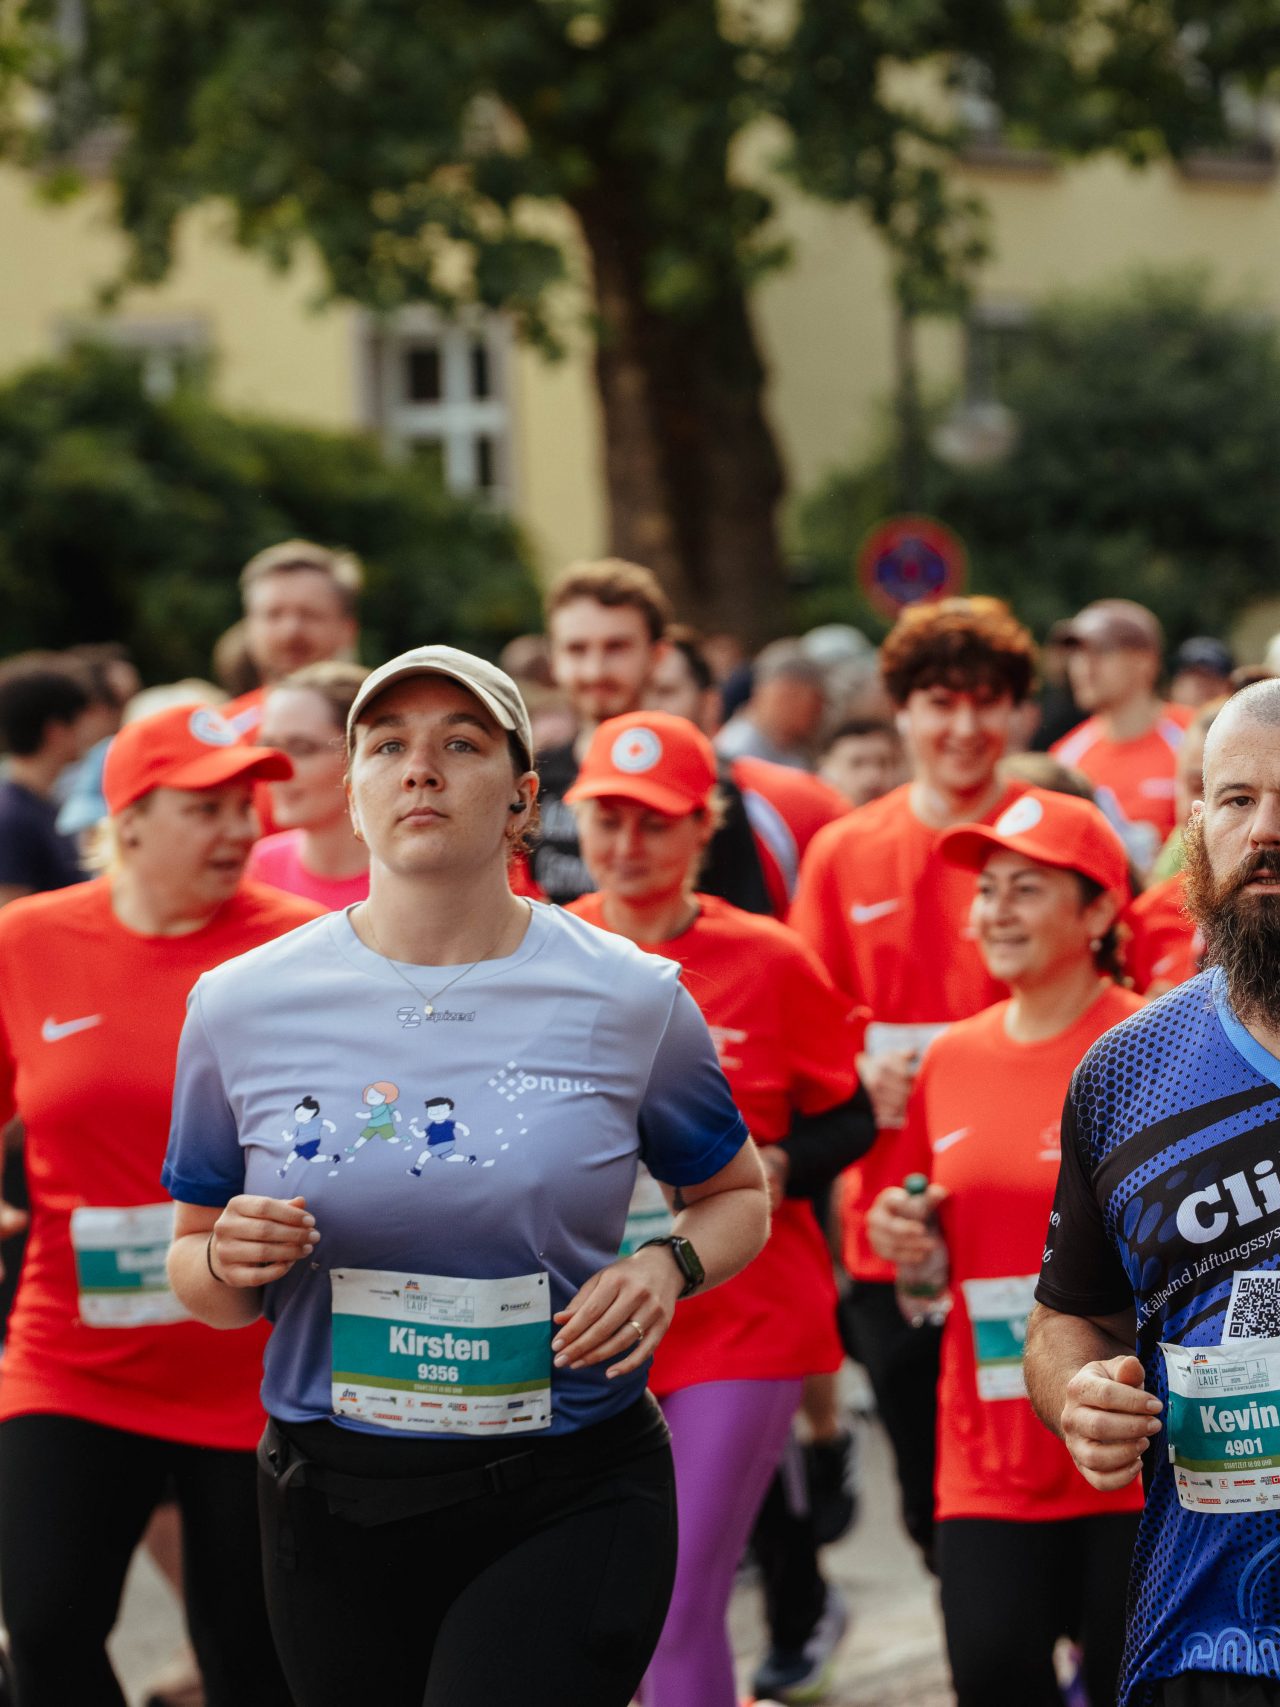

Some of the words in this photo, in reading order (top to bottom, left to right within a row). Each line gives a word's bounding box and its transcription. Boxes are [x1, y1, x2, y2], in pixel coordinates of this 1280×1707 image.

[389, 1325, 490, 1361] Kirsten
[417, 1363, 459, 1382] 9356
[1196, 1367, 1218, 1375] FIRMEN
[1198, 1376, 1219, 1386] LAUF
[1199, 1401, 1280, 1434] Kevin
[1224, 1437, 1264, 1456] 4901
